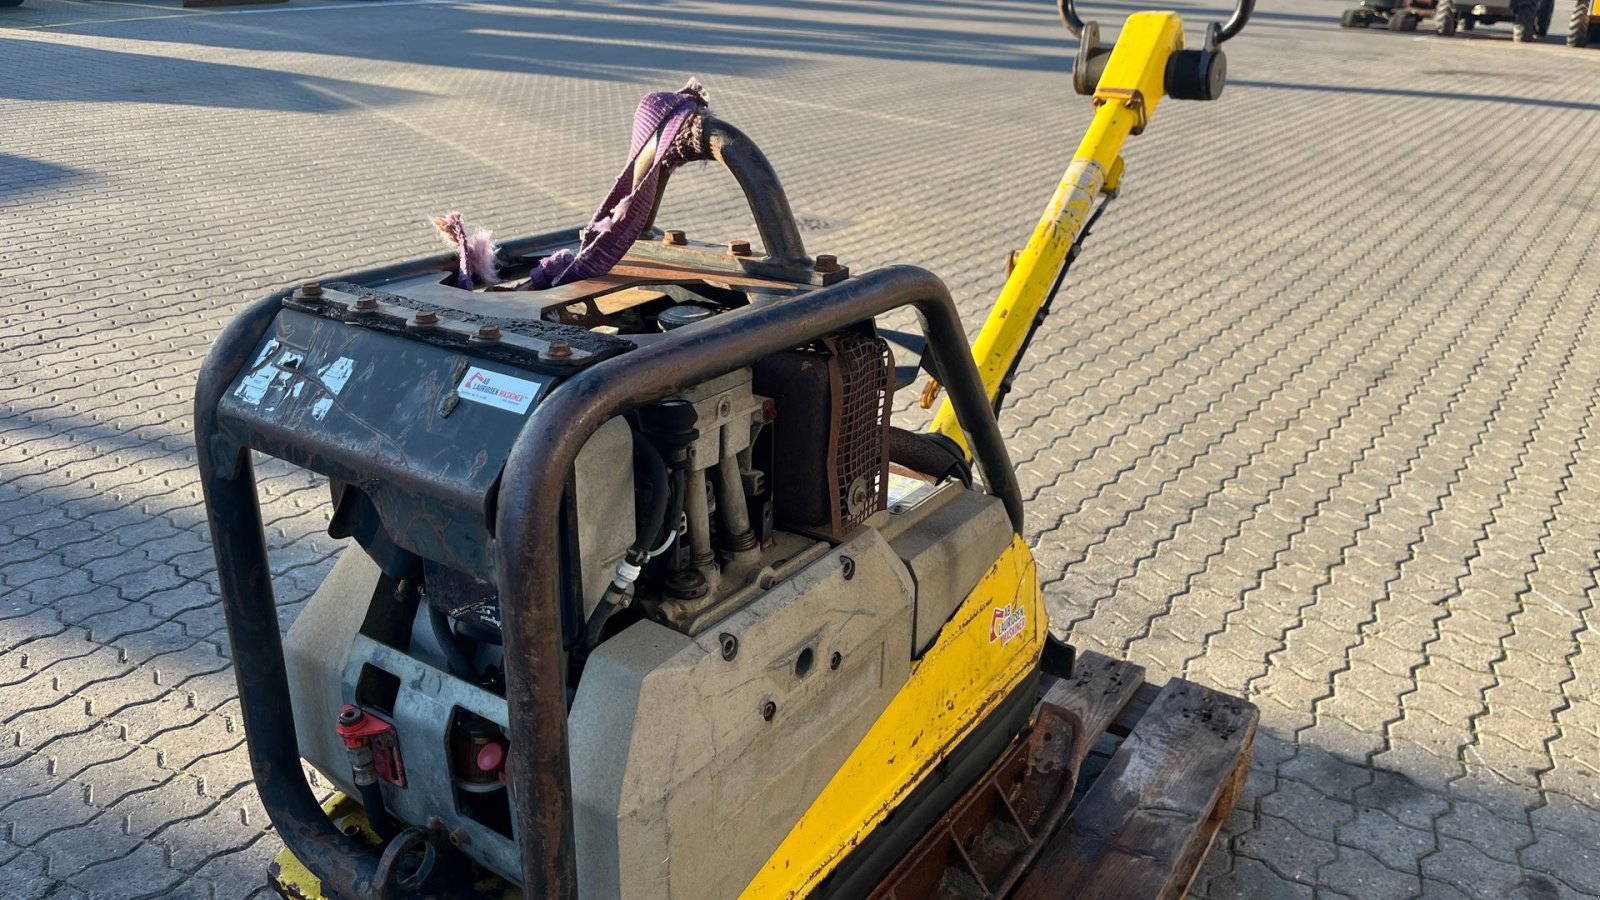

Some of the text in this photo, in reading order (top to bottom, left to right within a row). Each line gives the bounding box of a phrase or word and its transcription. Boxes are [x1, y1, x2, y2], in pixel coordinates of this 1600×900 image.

[482, 377, 491, 385] AB
[472, 383, 500, 396] LAURIDSEN
[499, 389, 525, 402] MASKINER
[1004, 605, 1010, 617] AB
[998, 608, 1024, 635] LAURIDSEN
[1002, 617, 1025, 643] MASKINER
